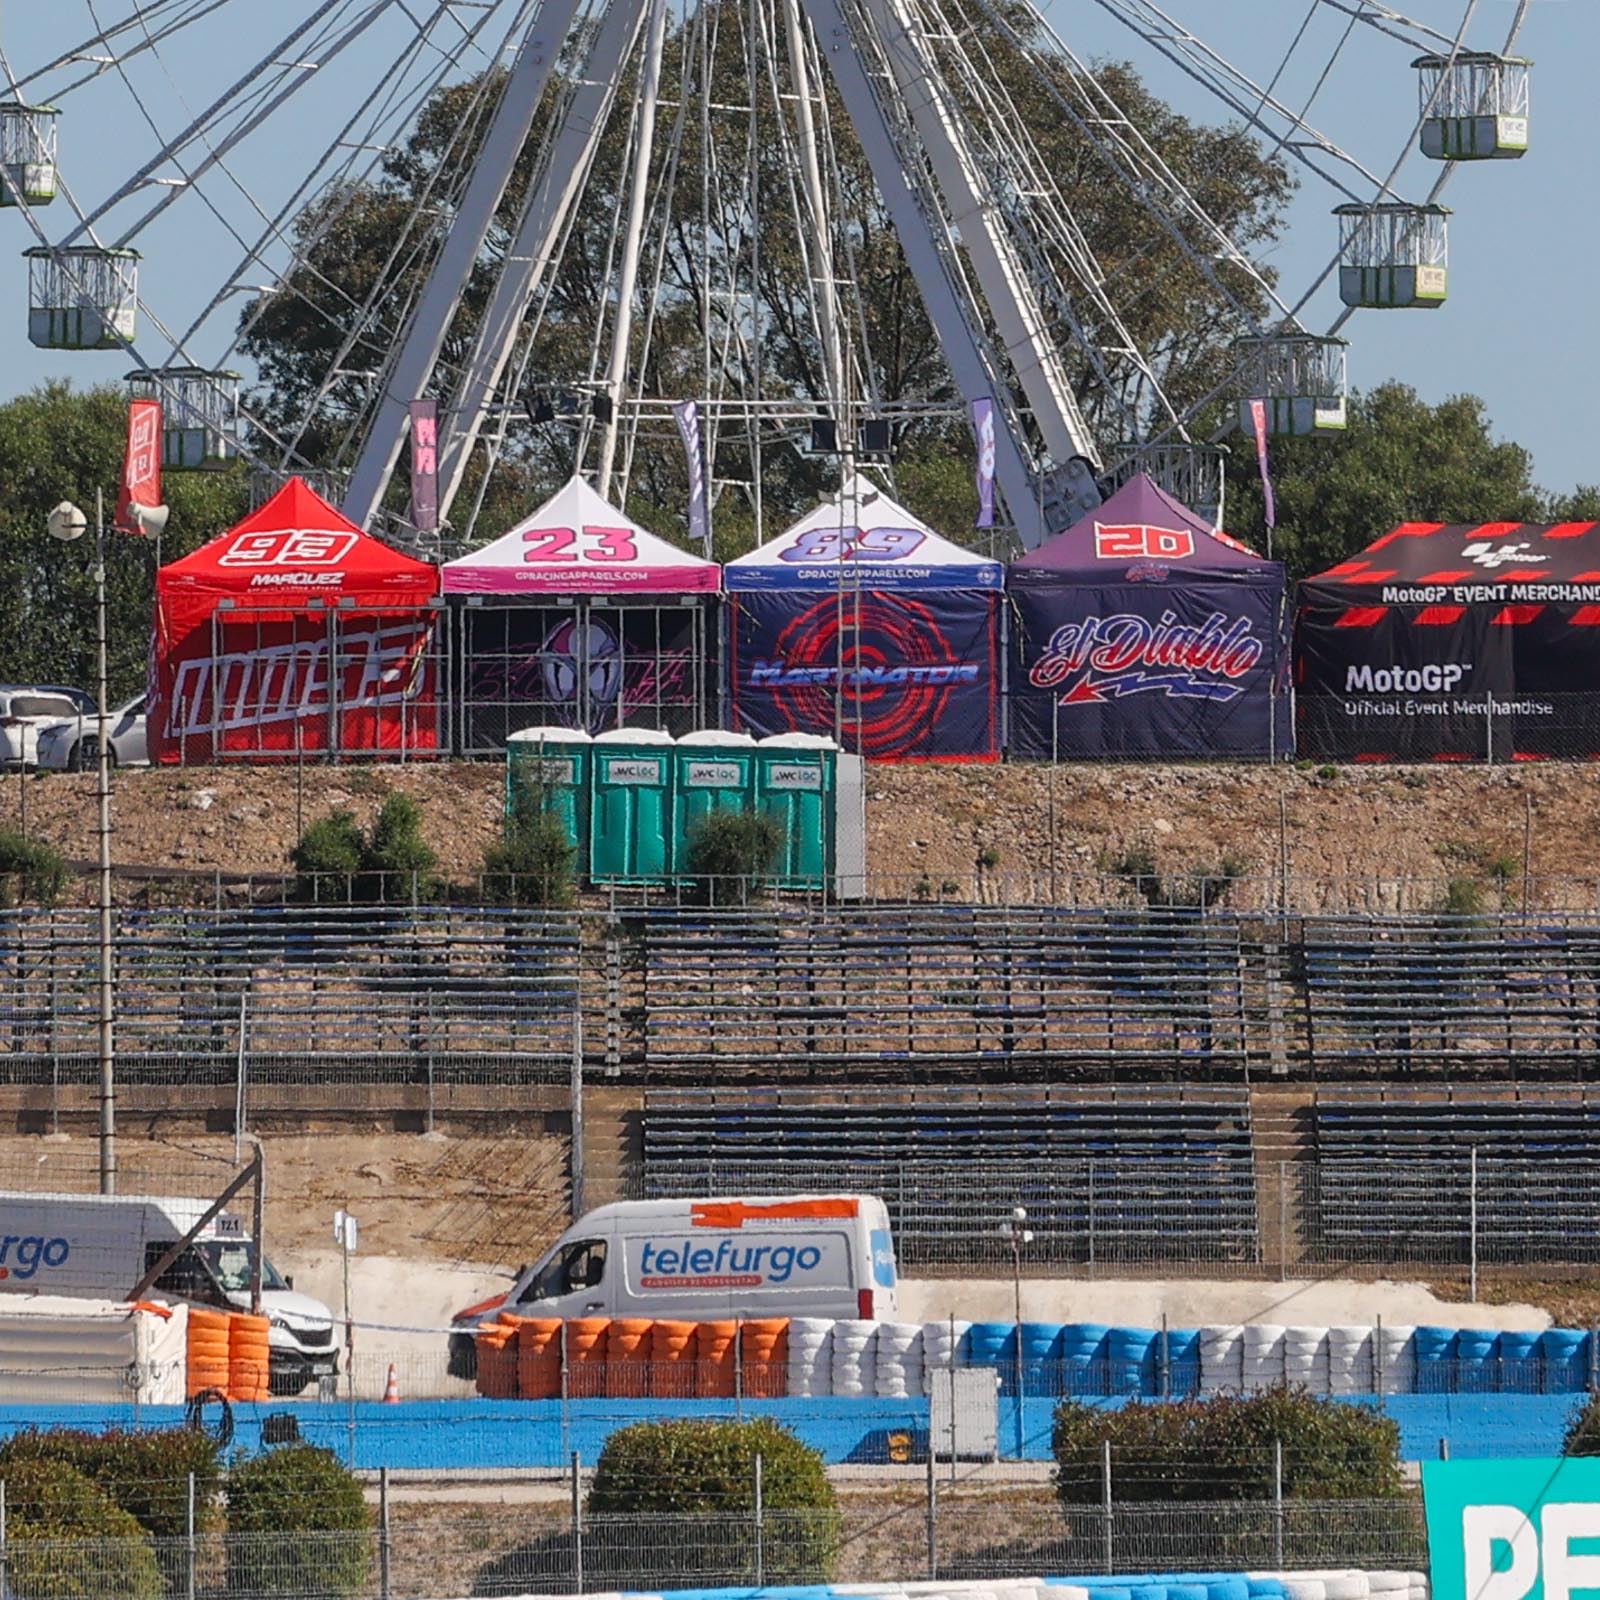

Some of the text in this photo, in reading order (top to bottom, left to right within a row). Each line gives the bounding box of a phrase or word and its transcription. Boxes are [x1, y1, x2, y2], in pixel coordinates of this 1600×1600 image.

[217, 528, 359, 567] 93
[522, 525, 638, 563] 23
[777, 526, 928, 562] 89
[1093, 520, 1195, 559] 20
[250, 571, 346, 586] MARQUEZ
[1454, 585, 1507, 601] EVENT
[1091, 610, 1262, 678] Diablo
[1345, 700, 1553, 715] Official Event Merchandise
[640, 1240, 822, 1283] telefurgo
